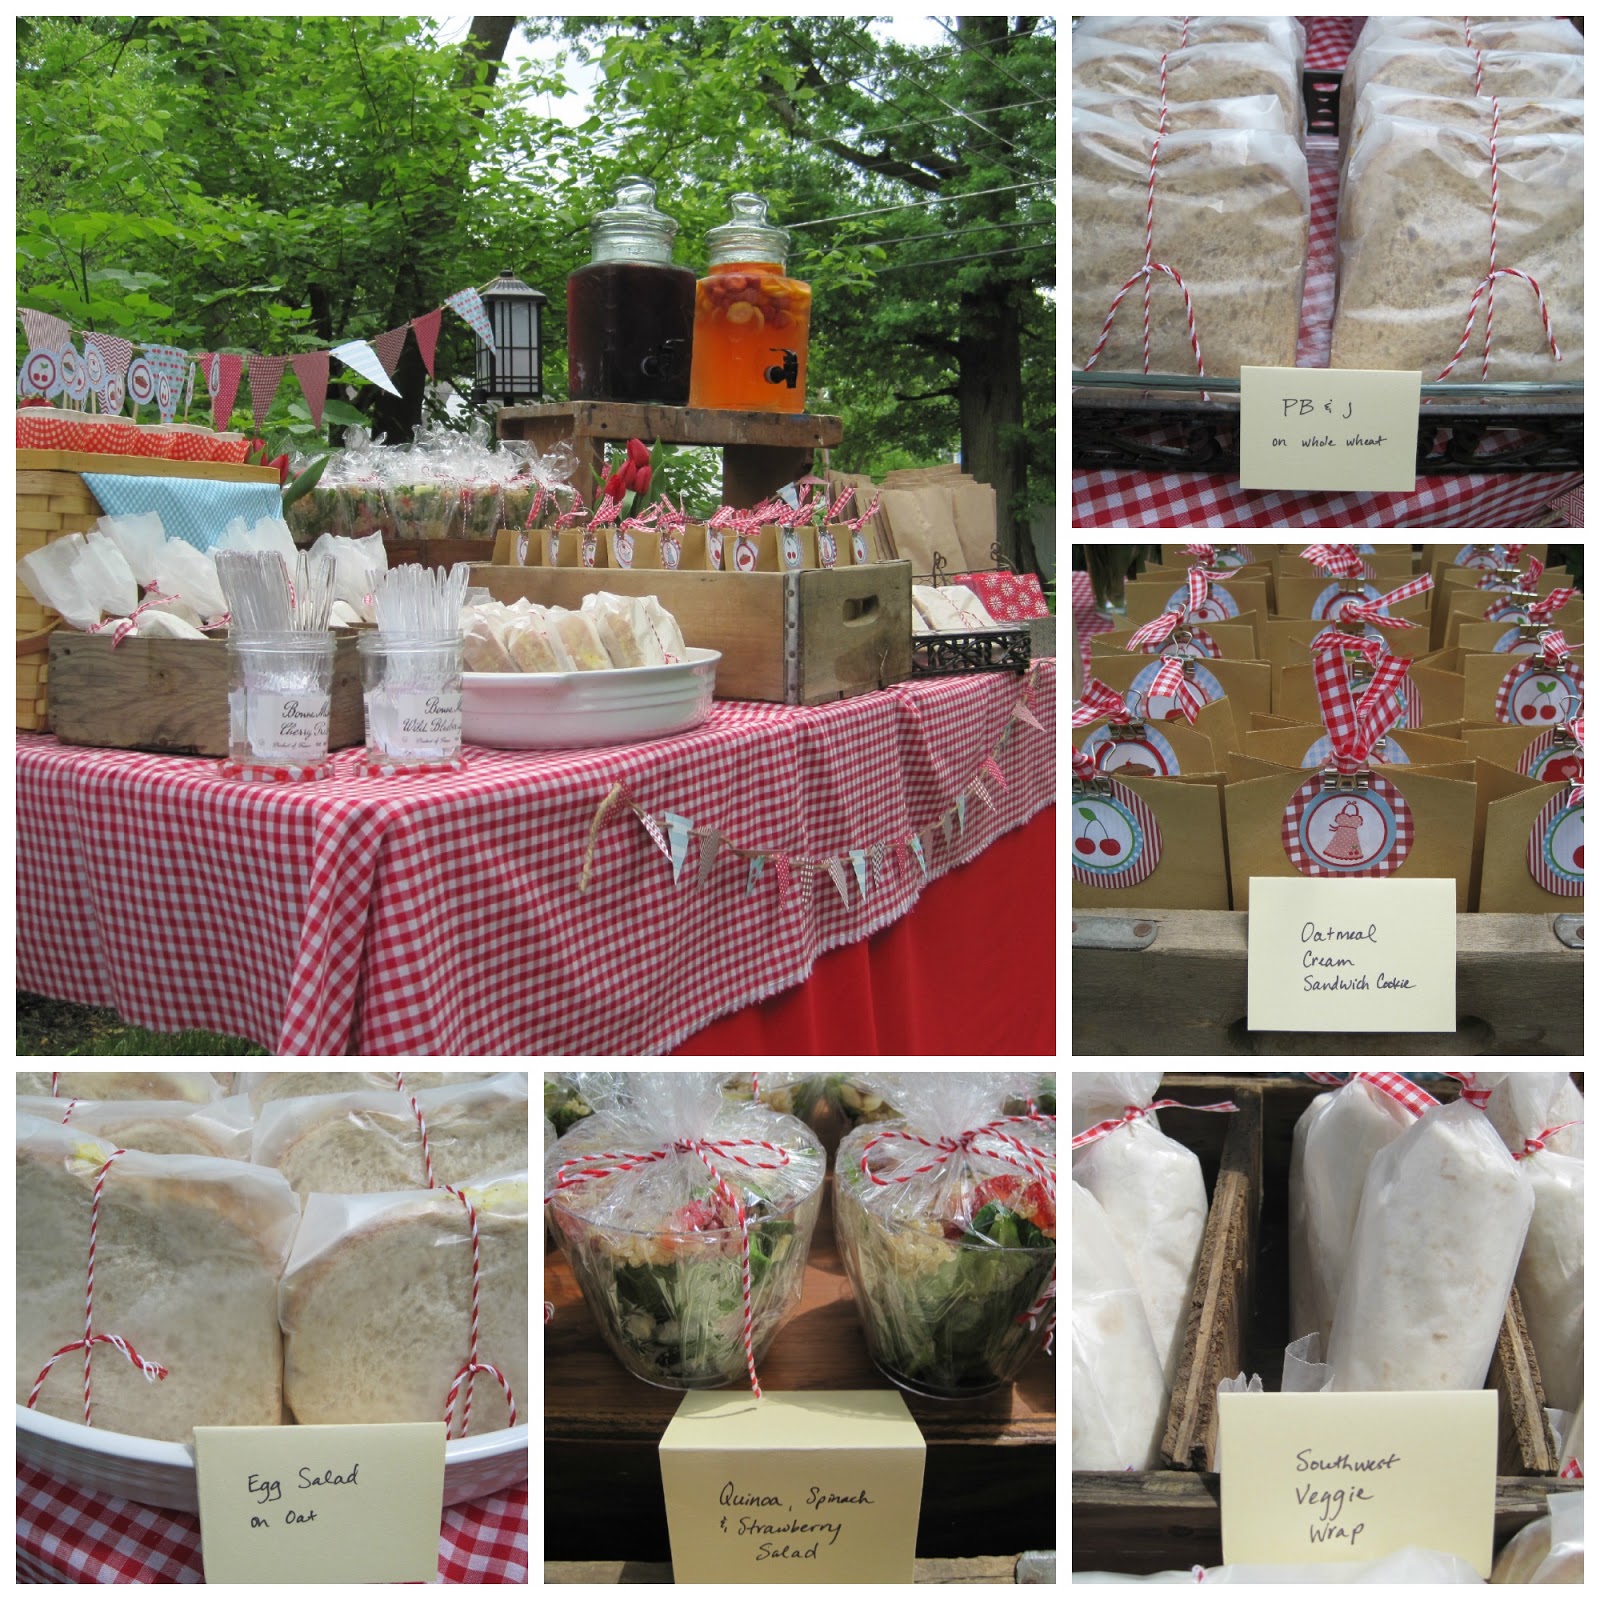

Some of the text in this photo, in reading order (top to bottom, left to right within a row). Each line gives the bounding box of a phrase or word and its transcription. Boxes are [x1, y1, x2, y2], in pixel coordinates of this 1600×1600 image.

[1281, 398, 1315, 417] PB
[1323, 398, 1333, 414] &
[1271, 433, 1388, 448] on whole wheat
[281, 700, 315, 718] Bonne
[279, 722, 312, 741] Cherry
[402, 718, 429, 733] Wild
[1300, 921, 1378, 944] Oatmeal
[1302, 949, 1356, 969] Cream
[1303, 972, 1417, 992] Sandwich Cookie
[1296, 1448, 1401, 1473] Southwest
[247, 1463, 360, 1505] Egg Salad
[805, 1486, 876, 1511] Spinach
[1295, 1483, 1375, 1521] Veggie
[250, 1509, 318, 1529] on Oat
[737, 1516, 842, 1546] Strawberry
[1309, 1522, 1365, 1546] Wrap
[755, 1542, 819, 1561] Salad
